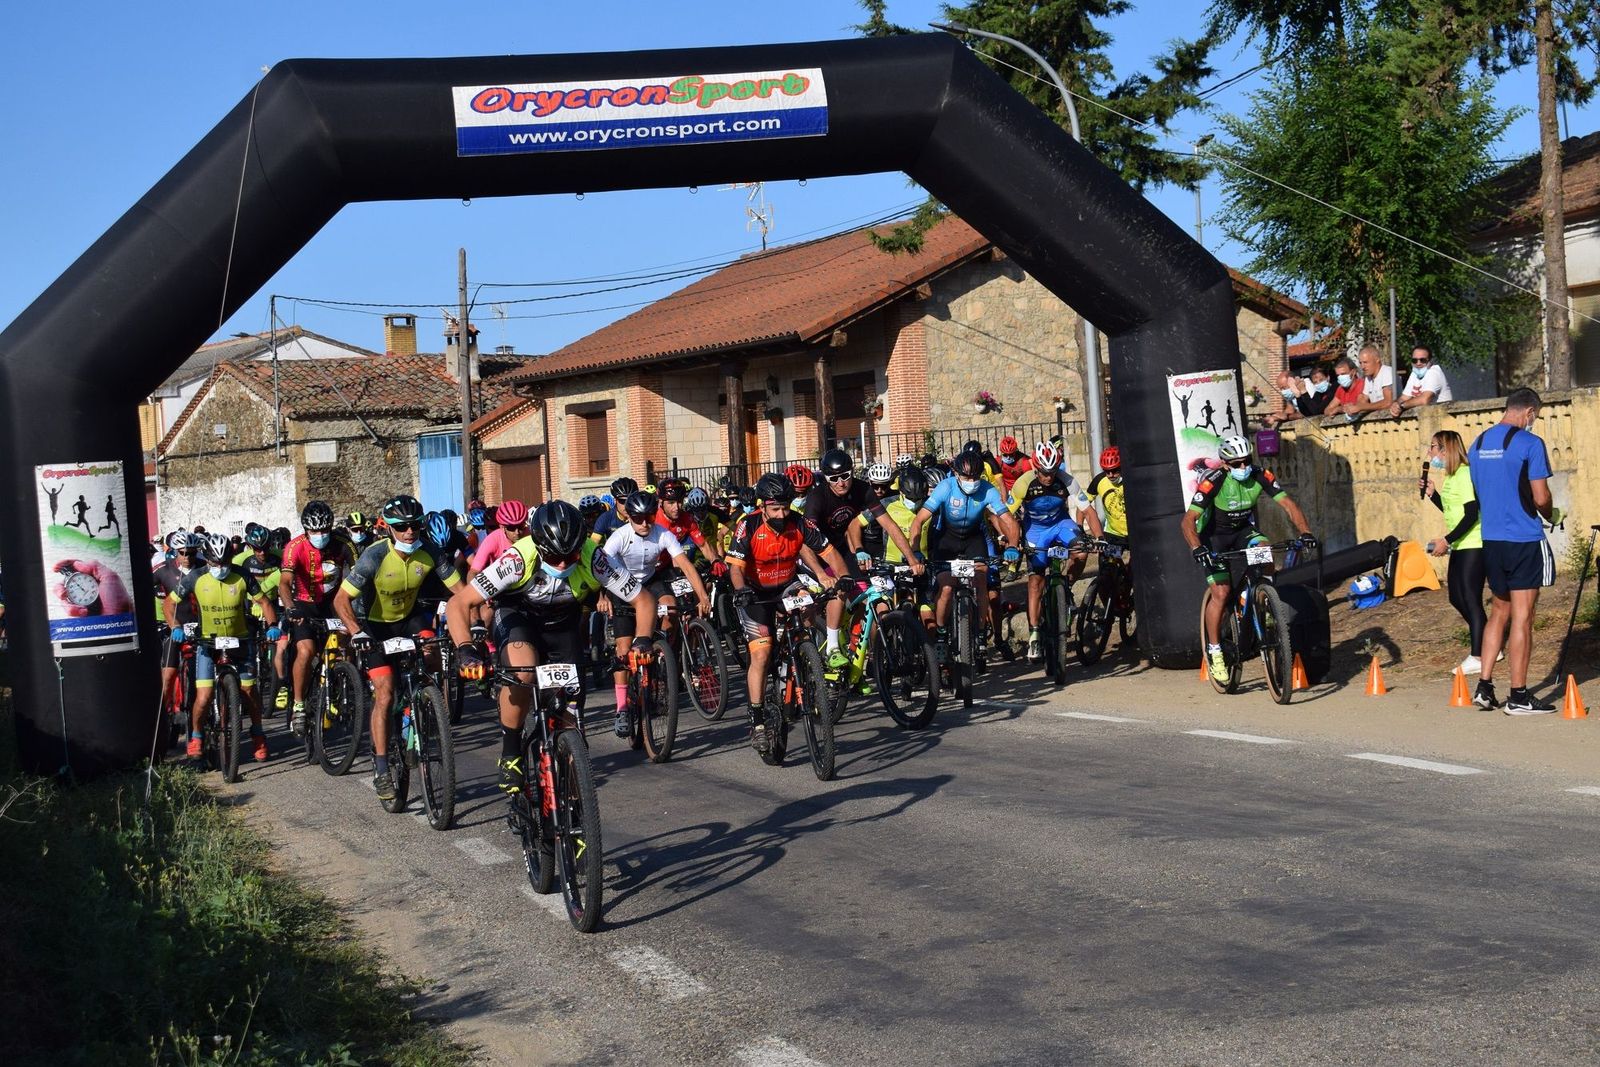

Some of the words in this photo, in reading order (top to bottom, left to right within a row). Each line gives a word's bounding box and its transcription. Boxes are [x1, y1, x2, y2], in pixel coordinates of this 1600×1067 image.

[470, 73, 810, 117] OrycronSport
[508, 116, 781, 145] www.orycronsport.com
[55, 620, 133, 633] www.orycronsport.com
[547, 671, 569, 681] 169
